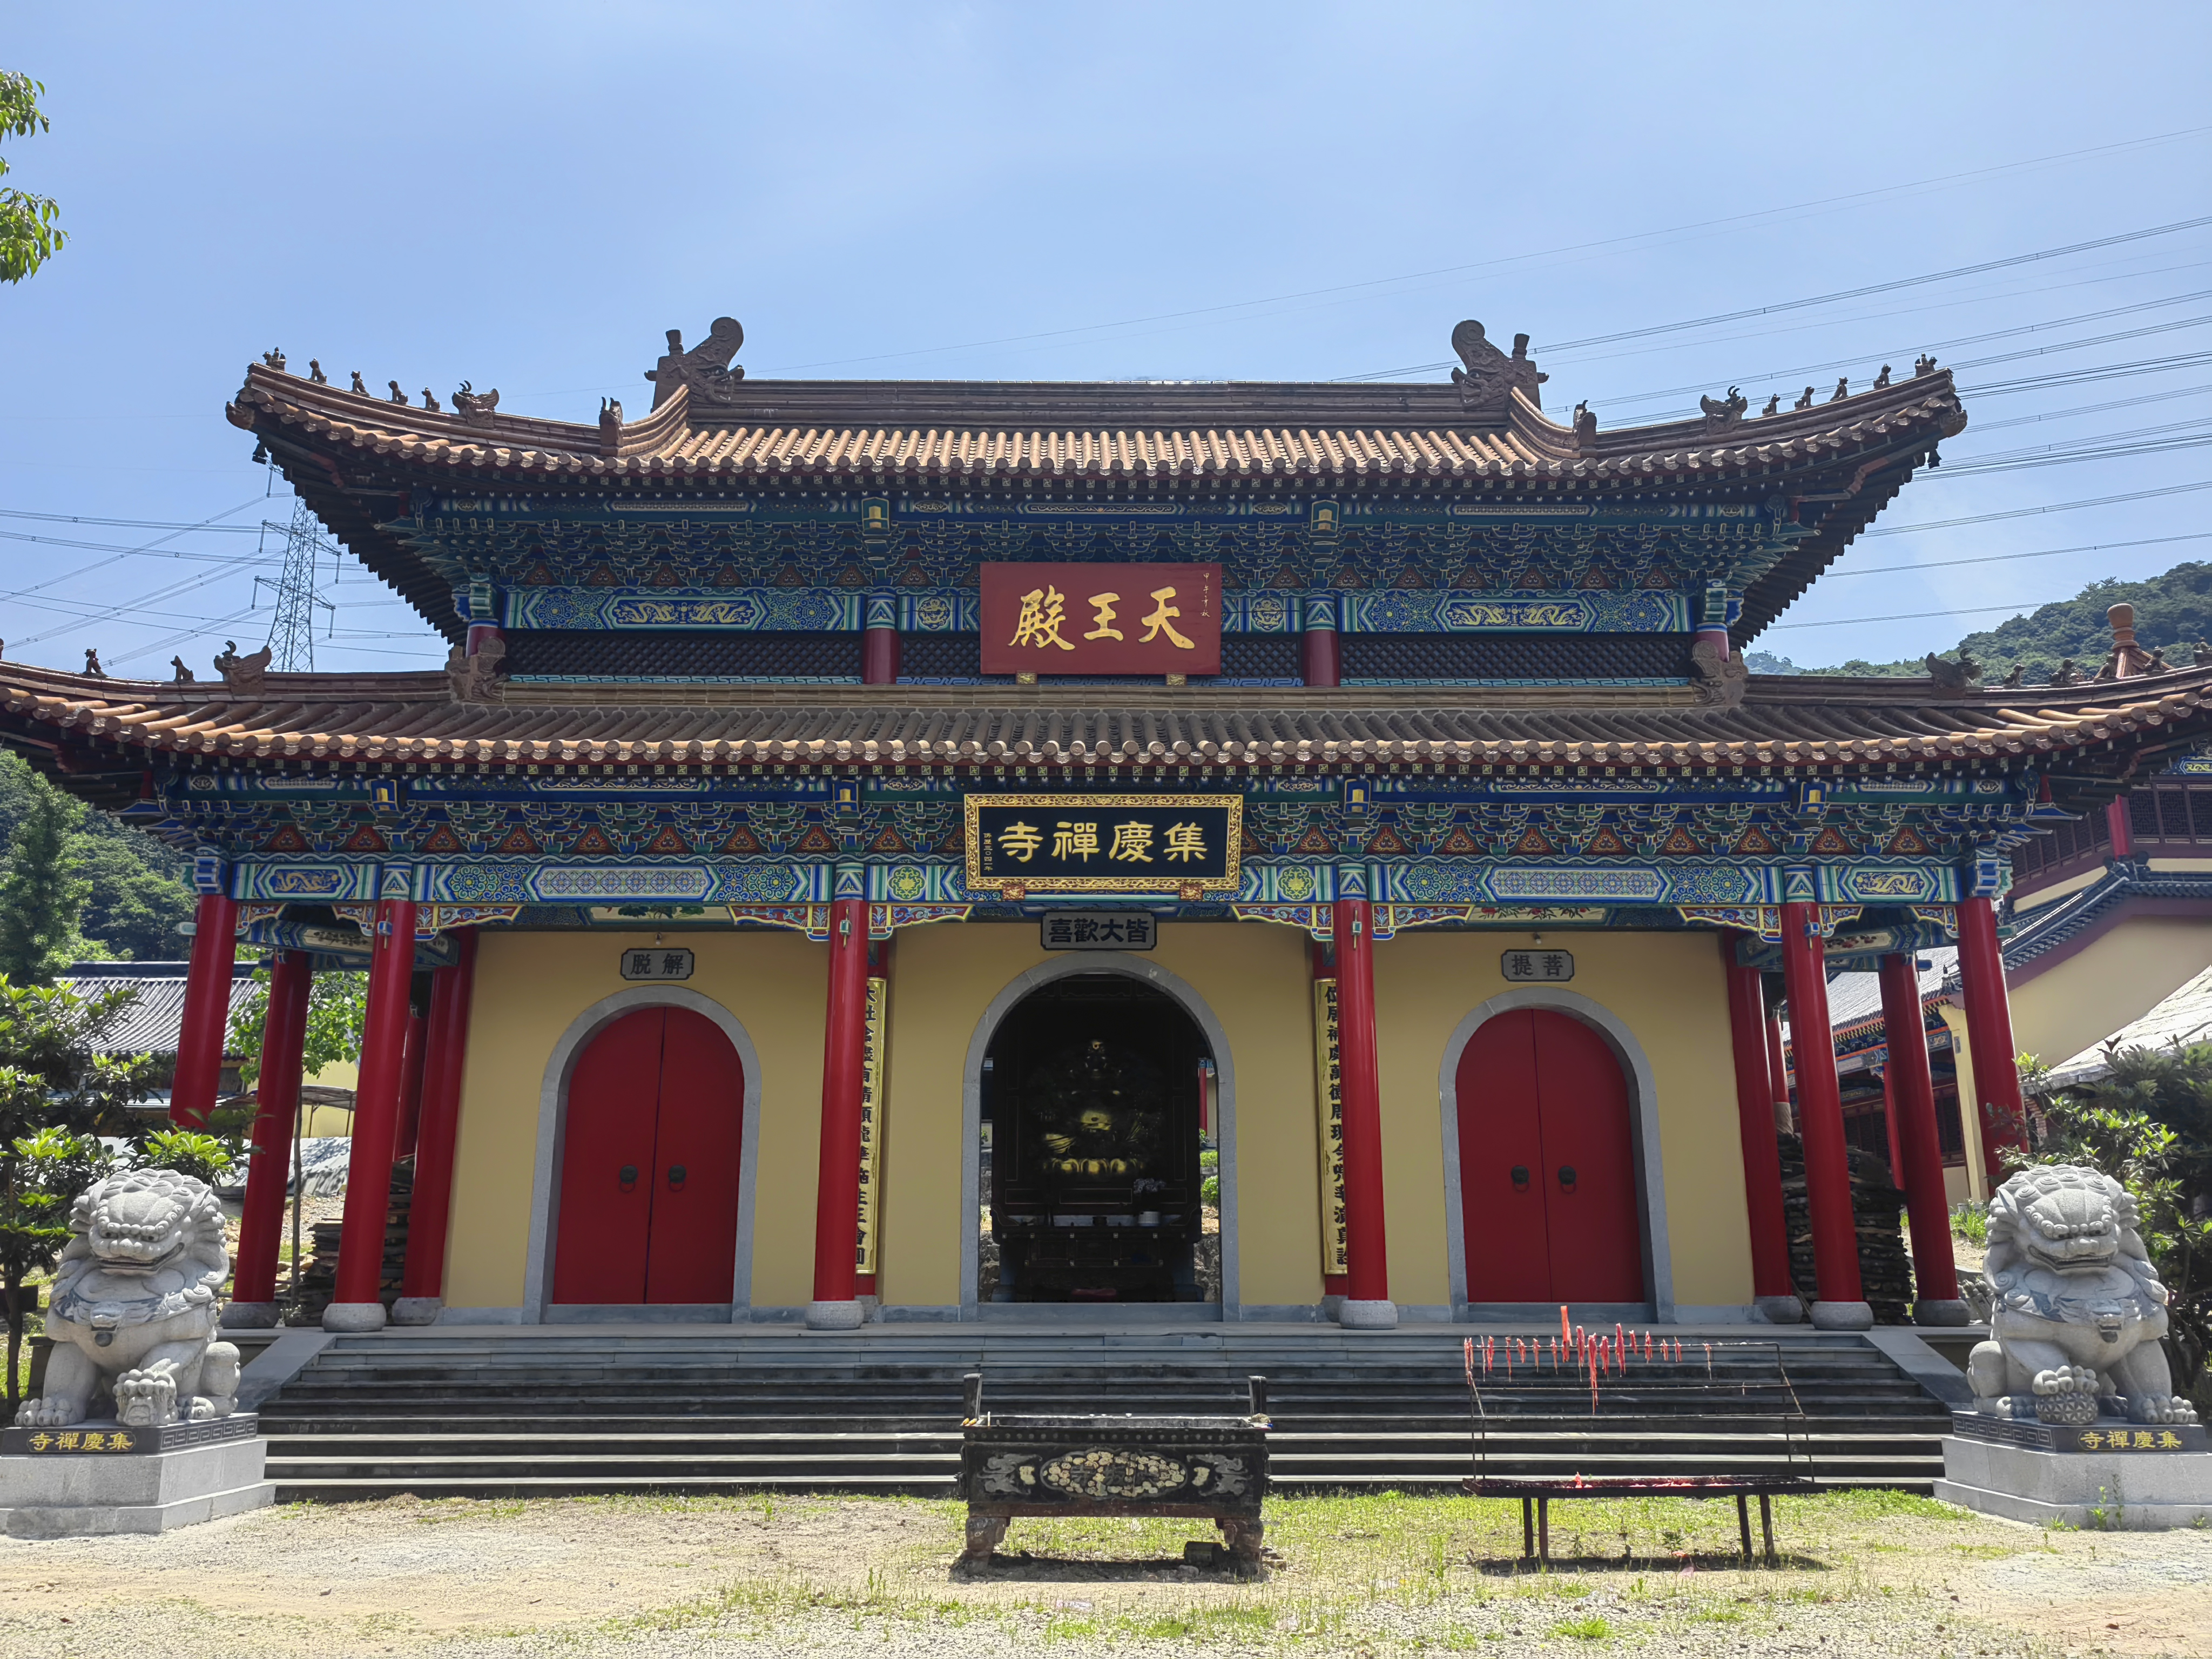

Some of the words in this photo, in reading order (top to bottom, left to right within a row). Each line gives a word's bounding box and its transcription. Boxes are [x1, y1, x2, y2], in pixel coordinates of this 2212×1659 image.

[1008, 584, 1195, 650] 天王殿
[997, 821, 1208, 862] 集慶禪寺
[1048, 918, 1150, 943] 皆大歡喜
[1511, 954, 1563, 976] 菩提
[29, 1432, 133, 1451] 集慶禪寺
[2080, 1431, 2182, 1449] 集慶禪寺
